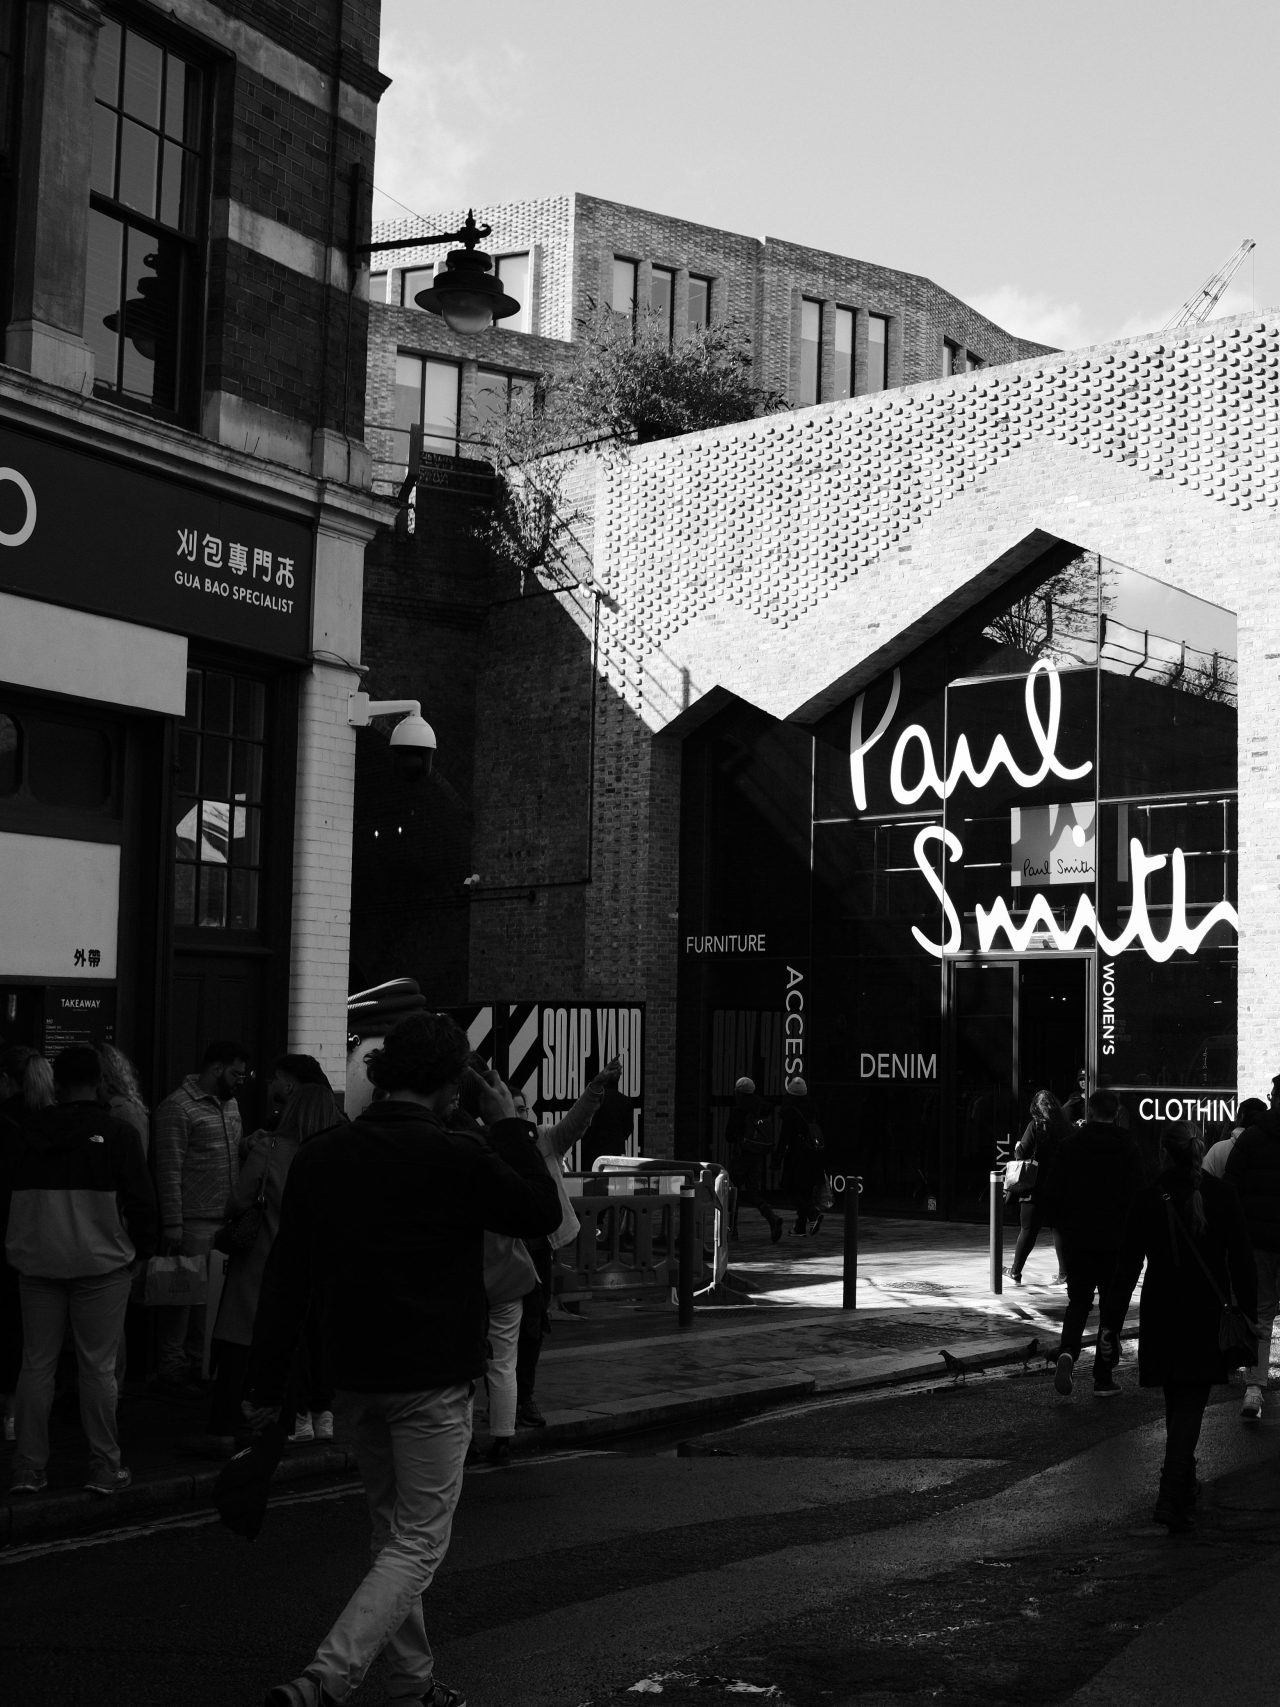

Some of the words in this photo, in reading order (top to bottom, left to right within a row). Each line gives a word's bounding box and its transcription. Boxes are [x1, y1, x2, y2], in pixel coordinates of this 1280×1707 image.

[174, 570, 201, 590] GUA
[204, 577, 230, 597] BAO
[232, 586, 294, 614] SPECIALIST
[850, 658, 1093, 811] Paul
[1023, 858, 1052, 877] Paul
[1056, 858, 1096, 875] Smith
[911, 825, 1238, 963] Smith
[685, 933, 767, 955] FURNITURE
[61, 998, 101, 1009] TAKEAWAY
[1102, 962, 1115, 1056] WOMEN'S
[542, 1007, 592, 1100] SOAP
[596, 1007, 642, 1098] YARD
[859, 1052, 938, 1080] DENIM
[1139, 1097, 1236, 1122] CLOTHIN
